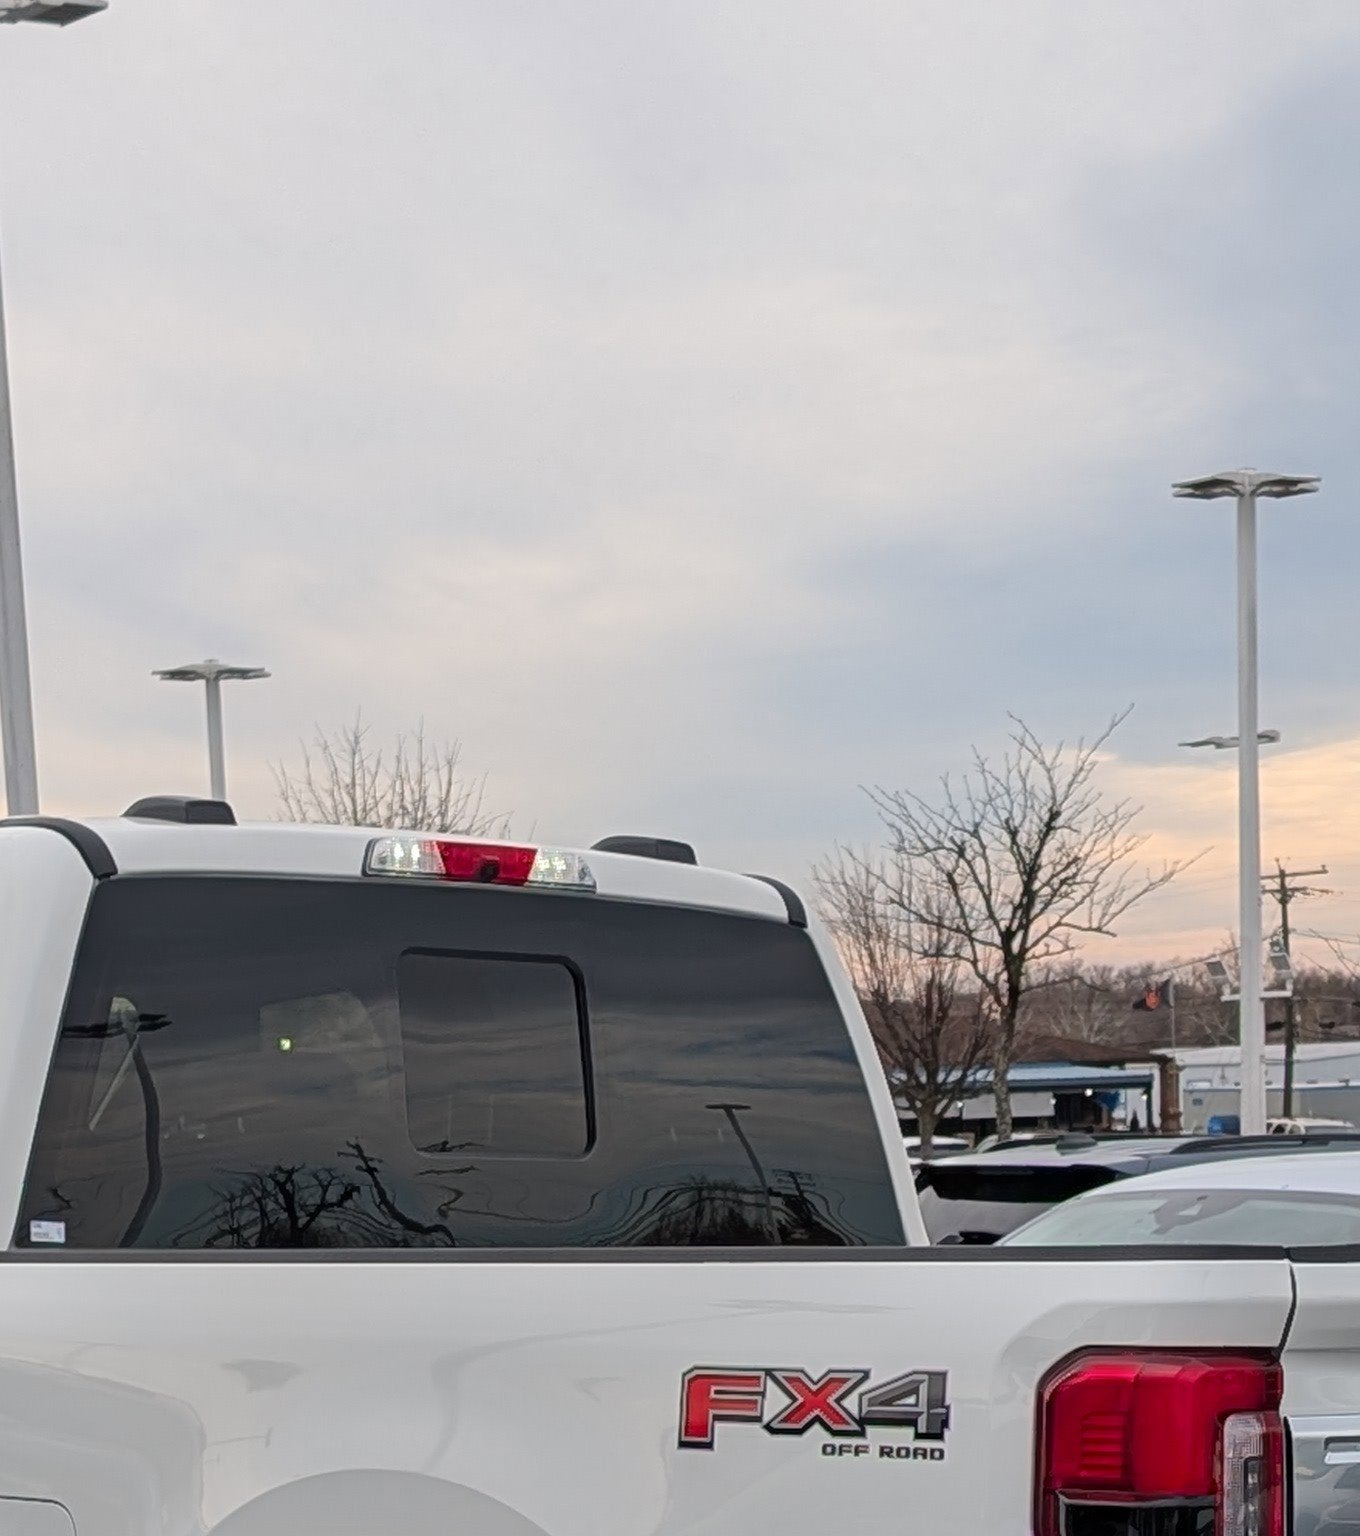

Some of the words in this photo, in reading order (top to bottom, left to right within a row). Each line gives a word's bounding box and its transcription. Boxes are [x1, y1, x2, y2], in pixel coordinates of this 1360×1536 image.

[677, 1366, 950, 1450] FX4
[822, 1443, 870, 1457] OFF
[879, 1445, 945, 1461] ROAD
